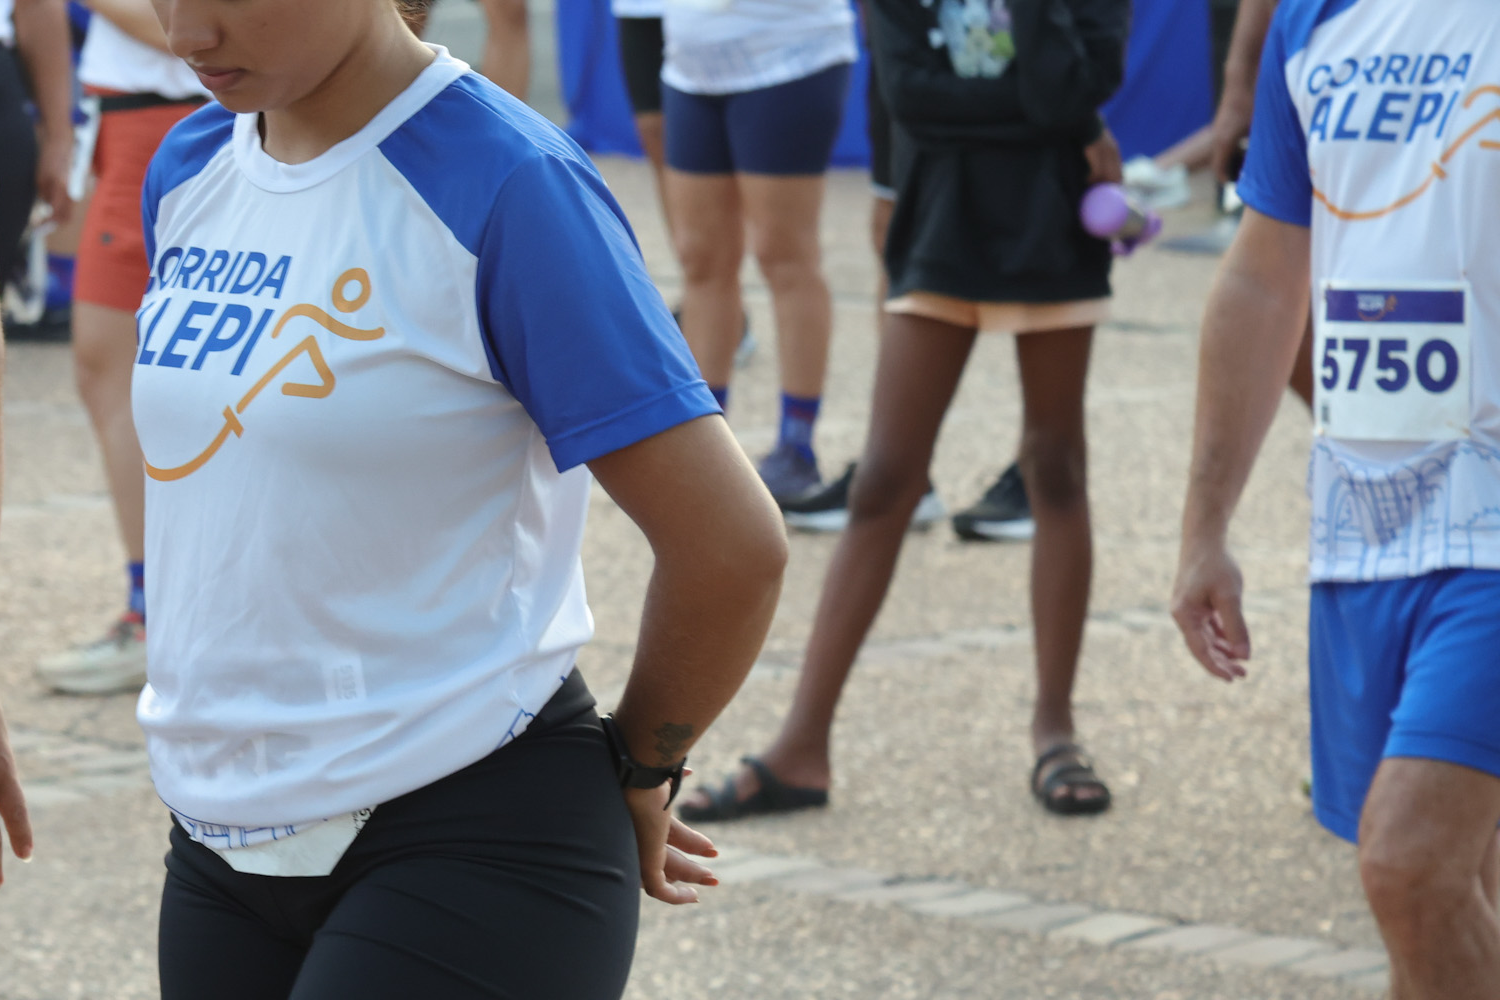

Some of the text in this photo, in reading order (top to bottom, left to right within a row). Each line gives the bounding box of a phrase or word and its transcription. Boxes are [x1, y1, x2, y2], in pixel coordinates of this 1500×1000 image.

[1307, 52, 1472, 95] CORRIDA
[1308, 90, 1460, 143] ALEPI
[146, 246, 293, 299] ORRIDA
[136, 297, 275, 376] LEPI
[1320, 338, 1460, 394] 5750
